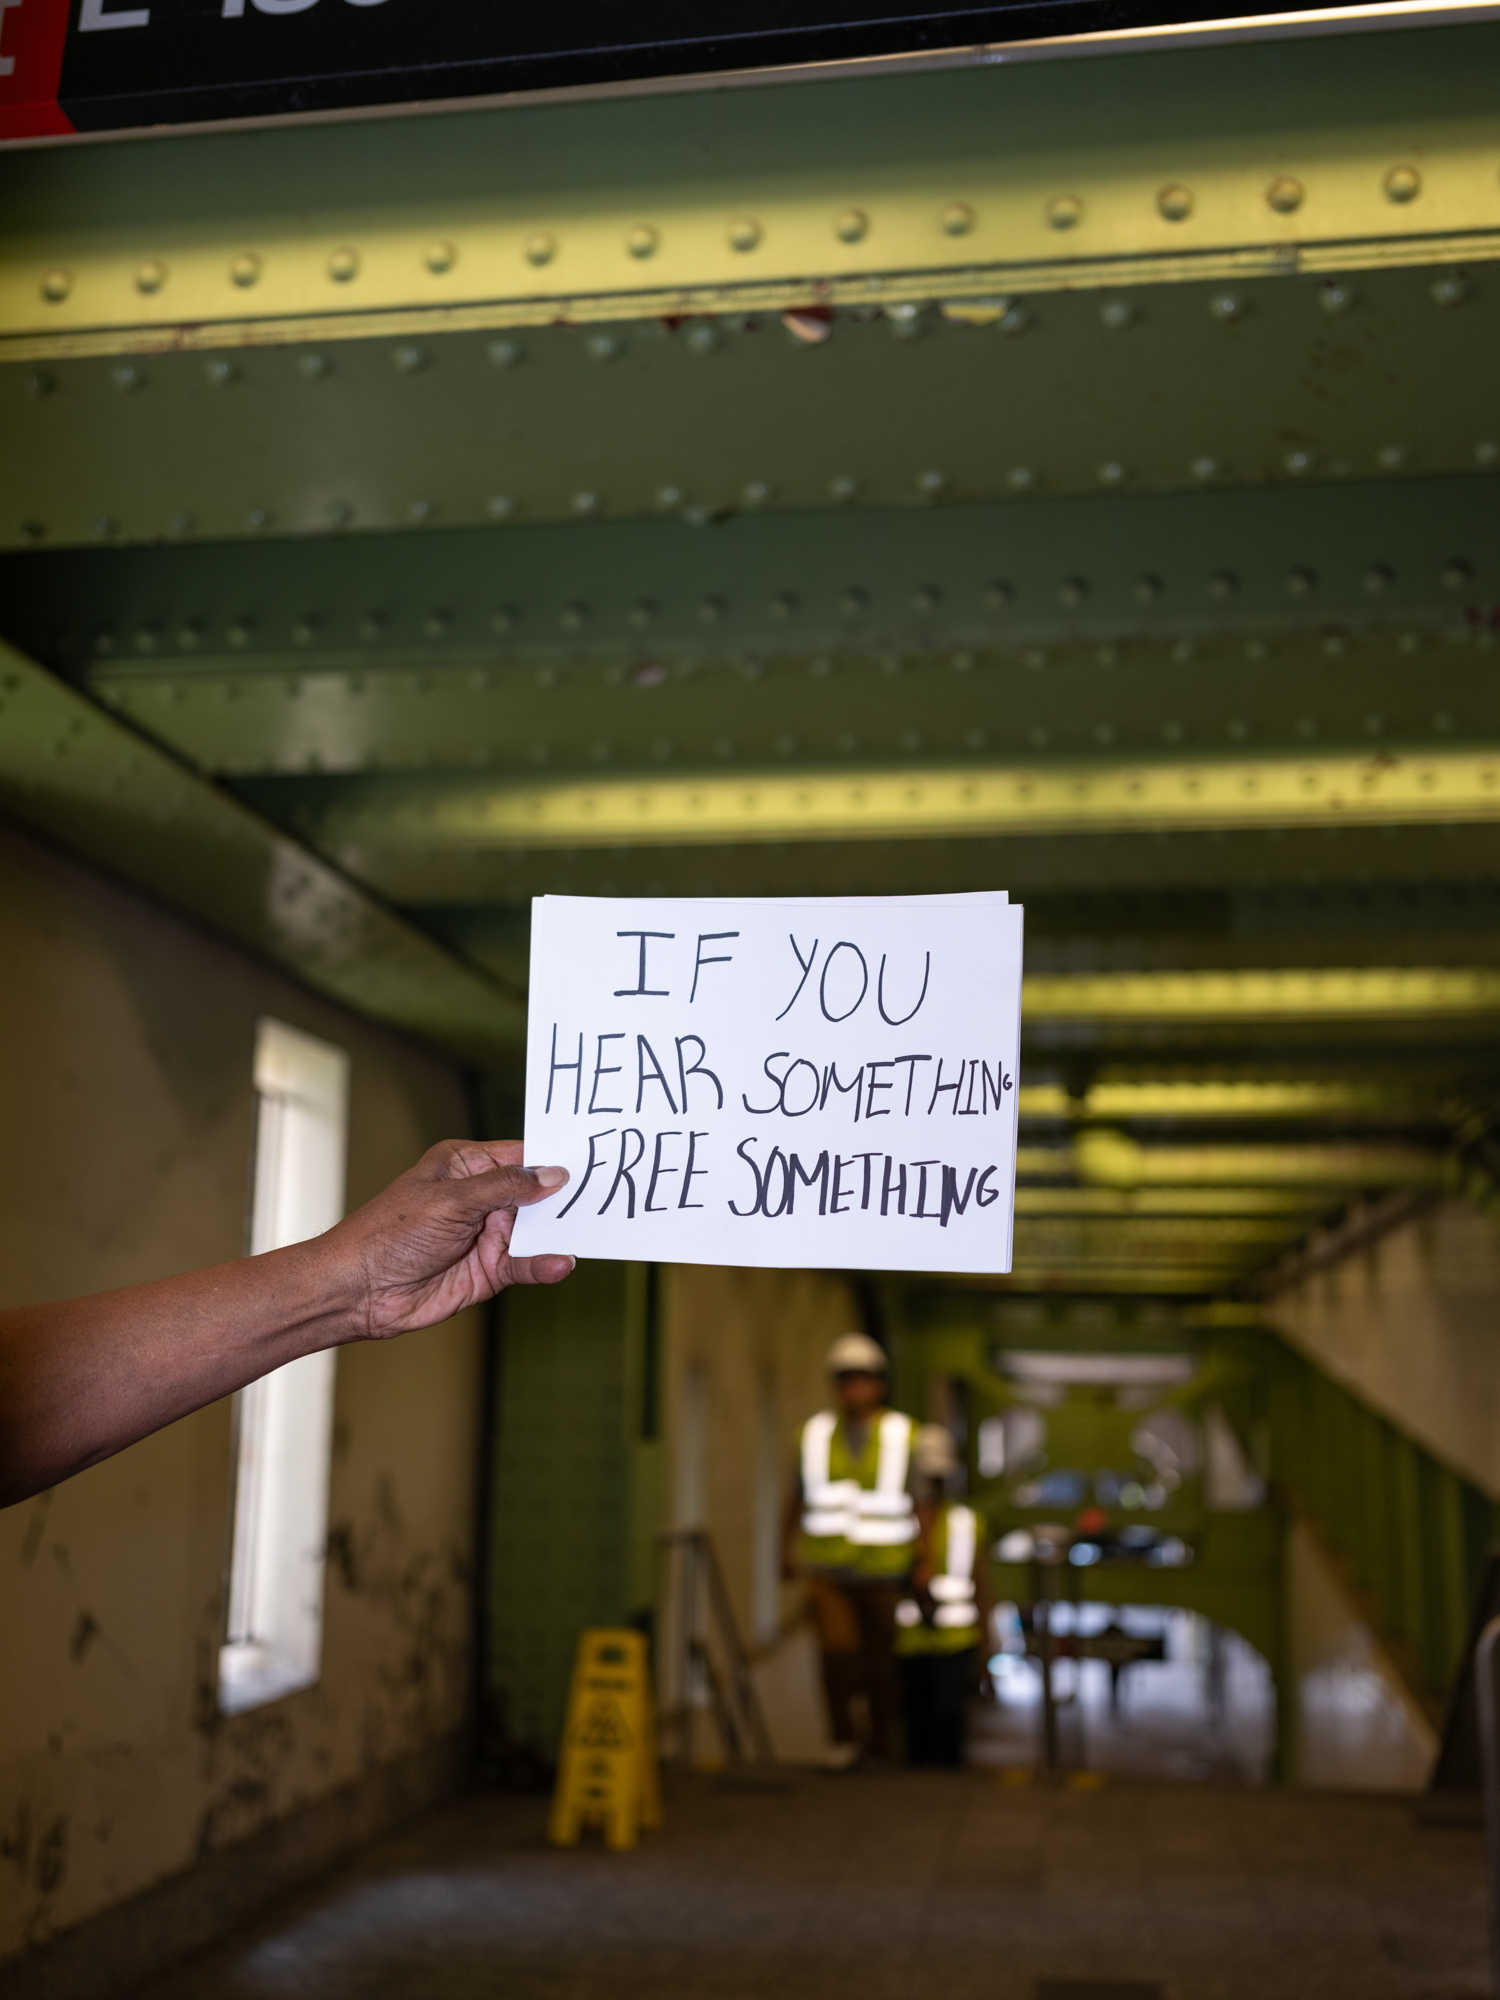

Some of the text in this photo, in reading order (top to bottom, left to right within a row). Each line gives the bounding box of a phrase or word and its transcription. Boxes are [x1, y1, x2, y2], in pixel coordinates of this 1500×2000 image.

[614, 932, 930, 1025] IF YOU
[546, 1023, 1012, 1122] HEAR SOMETHING
[556, 1129, 999, 1227] FREE SOMETHING
